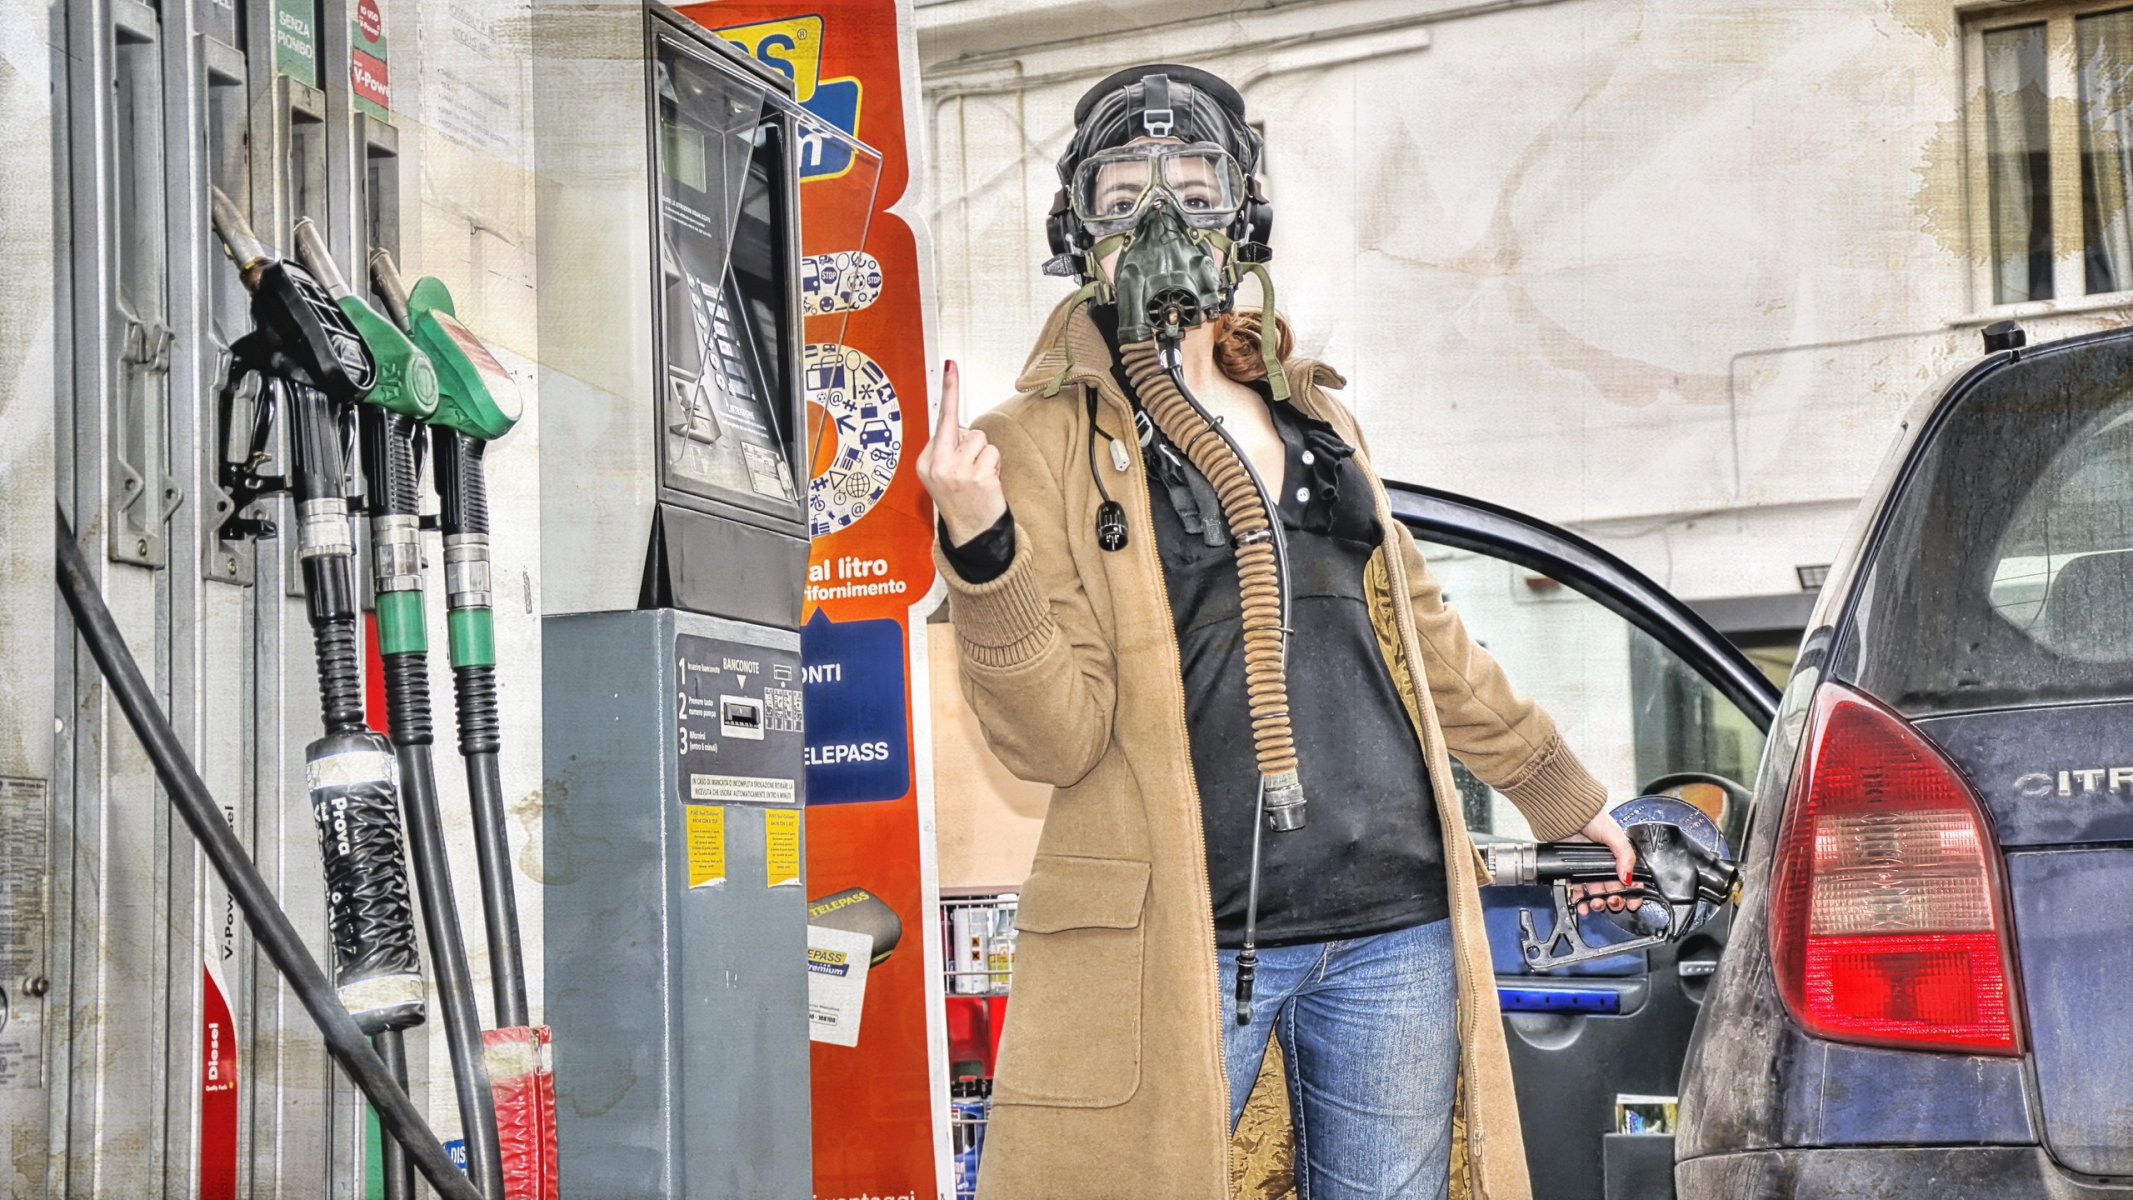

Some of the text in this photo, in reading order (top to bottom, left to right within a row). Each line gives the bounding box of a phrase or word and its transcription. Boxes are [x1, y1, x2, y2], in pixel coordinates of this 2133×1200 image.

[279, 10, 310, 38] SENZA
[277, 30, 312, 59] PIOMBO
[822, 271, 837, 280] STOP
[867, 276, 881, 284] STOP
[809, 556, 888, 582] al litro
[679, 657, 685, 685] 1
[702, 664, 720, 674] banconote
[723, 658, 760, 674] BANCONOTE
[679, 692, 687, 719] 2
[680, 727, 688, 754] 3
[2013, 766, 2133, 797] CITR
[331, 796, 350, 857] Prova
[808, 891, 871, 917] TELEPASS
[208, 1023, 219, 1080] Diesel
